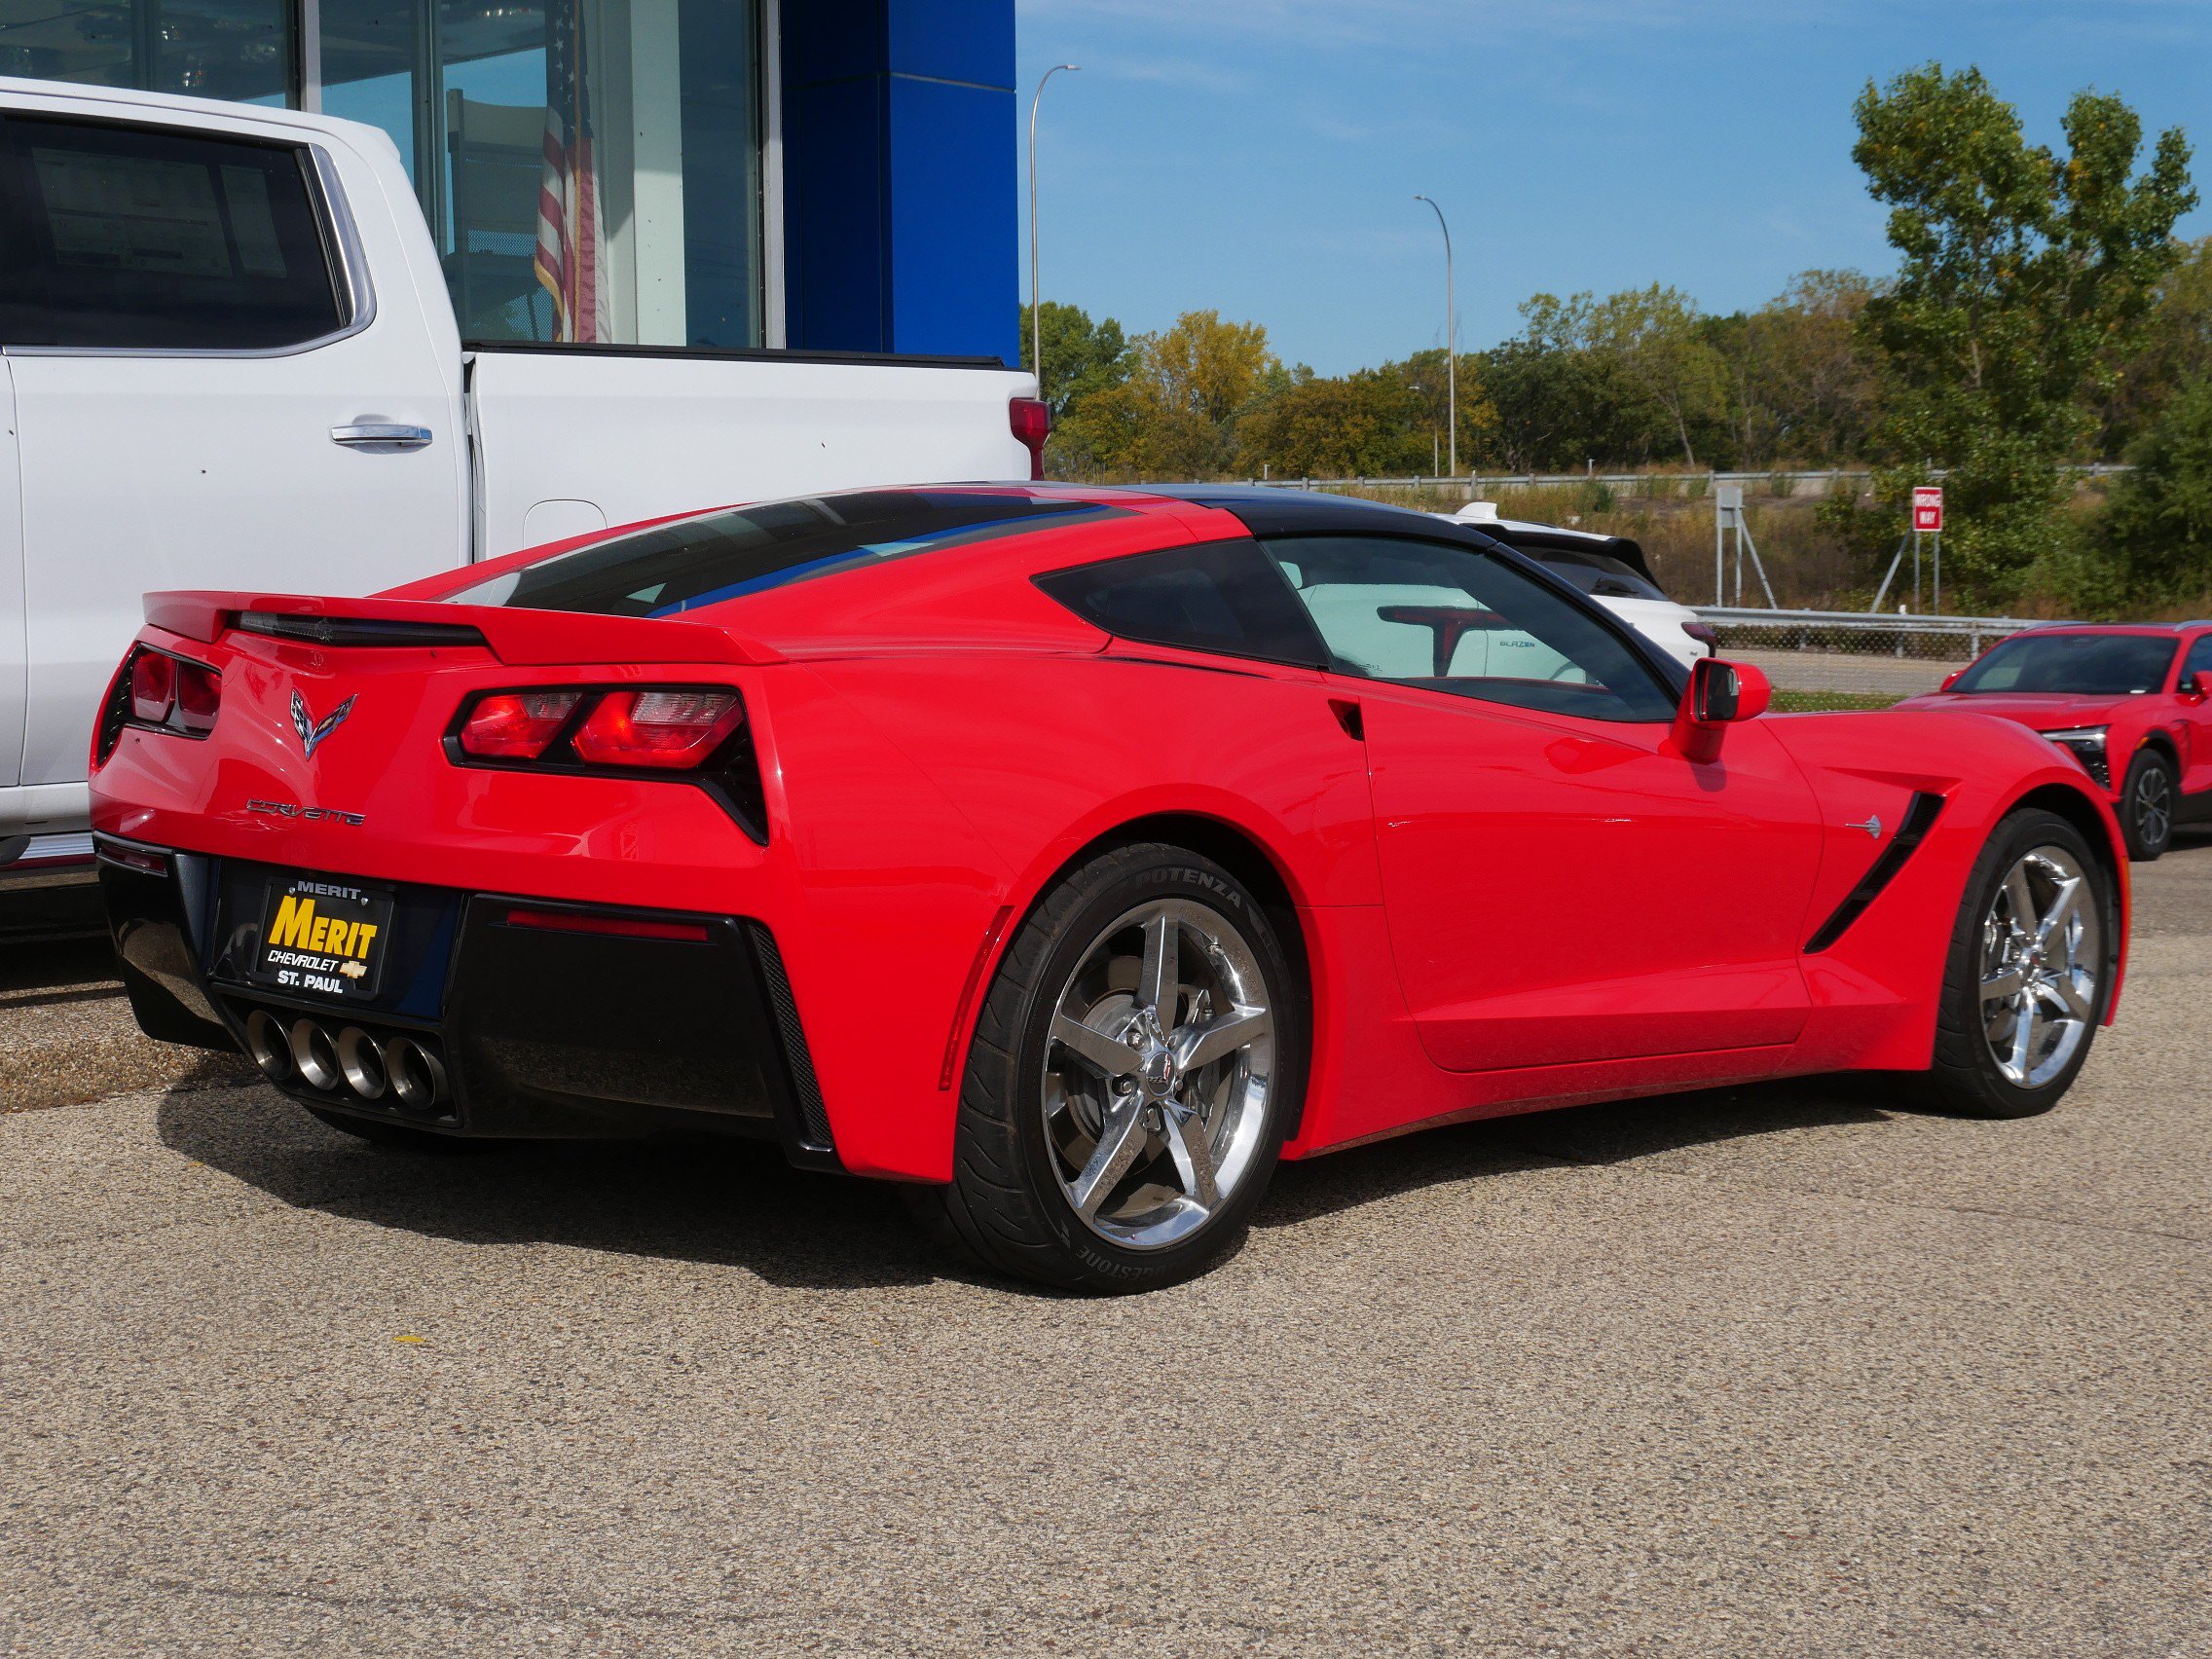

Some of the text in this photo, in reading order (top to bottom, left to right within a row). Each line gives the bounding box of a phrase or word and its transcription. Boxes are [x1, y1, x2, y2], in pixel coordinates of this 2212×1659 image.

[1915, 494, 1941, 506] WRONG
[1919, 511, 1936, 525] WAY
[246, 798, 367, 826] CORVETTE
[297, 881, 361, 900] MERIT
[1136, 867, 1241, 909] POTENZA
[268, 949, 339, 972] CHEVROLET
[277, 971, 343, 993] ST. PAUL
